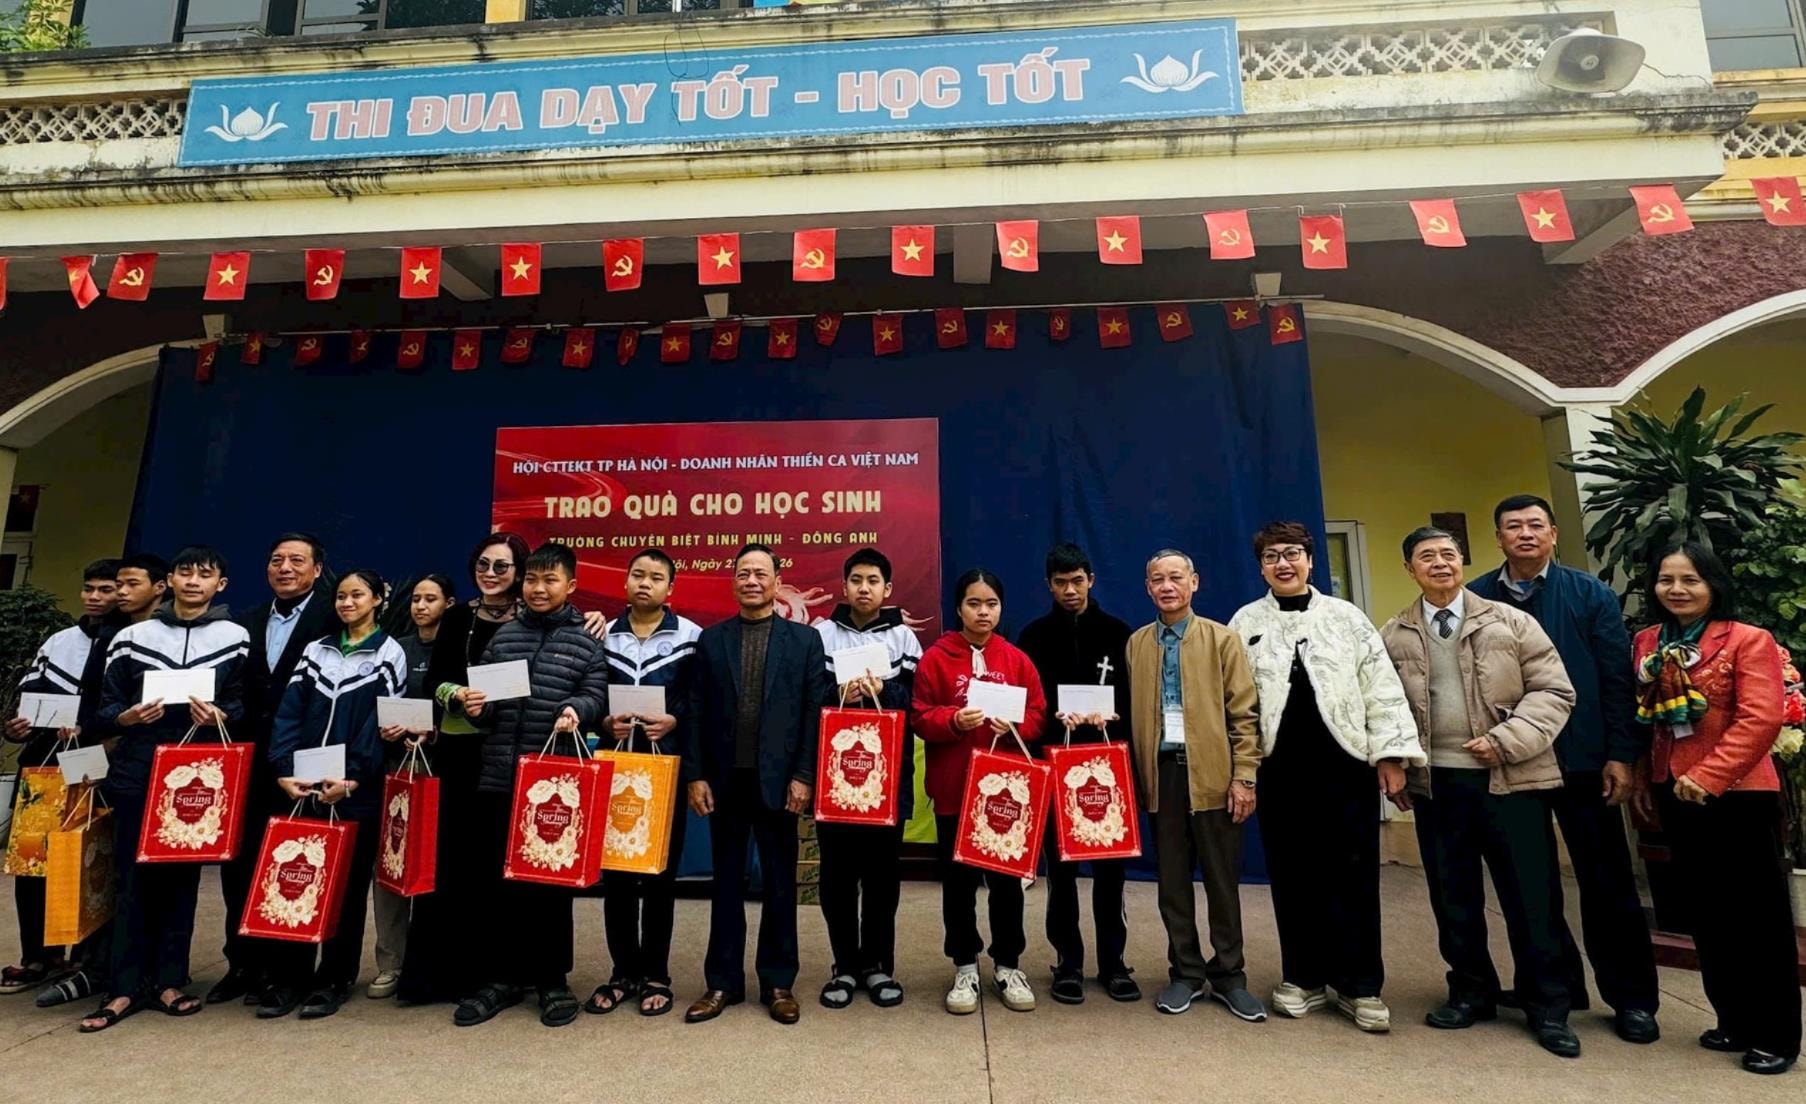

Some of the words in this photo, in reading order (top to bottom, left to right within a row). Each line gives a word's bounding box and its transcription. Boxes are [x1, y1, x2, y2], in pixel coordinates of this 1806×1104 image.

[306, 98, 394, 141] THI
[407, 91, 523, 136] ĐUA
[539, 82, 657, 135] DẠY
[671, 64, 779, 122] TỐT
[794, 90, 820, 104] -
[837, 66, 962, 119] HỌC
[977, 46, 1091, 106] TỐT
[513, 460, 539, 475] HỘI
[543, 460, 594, 474] CTTEKT
[597, 459, 614, 472] TP
[617, 456, 637, 472] HÀ
[641, 456, 668, 473] NỘI
[680, 457, 732, 470] DOANH
[736, 453, 778, 469] NHÂN
[828, 454, 847, 467] CA
[851, 452, 881, 469] VIỆT
[885, 453, 919, 466] NAM
[544, 495, 612, 519] TRAO
[623, 489, 678, 519] QUÀ
[690, 492, 744, 516] CHO
[755, 491, 810, 519] HỌC
[821, 490, 881, 514] SINH
[611, 533, 666, 548] CHUYÊN
[671, 533, 701, 549] BIỆT
[746, 533, 782, 545] MINH
[802, 531, 843, 544] ĐÔNG
[849, 532, 878, 544] ANH
[673, 559, 688, 572] ội,
[691, 559, 722, 572] Ngày
